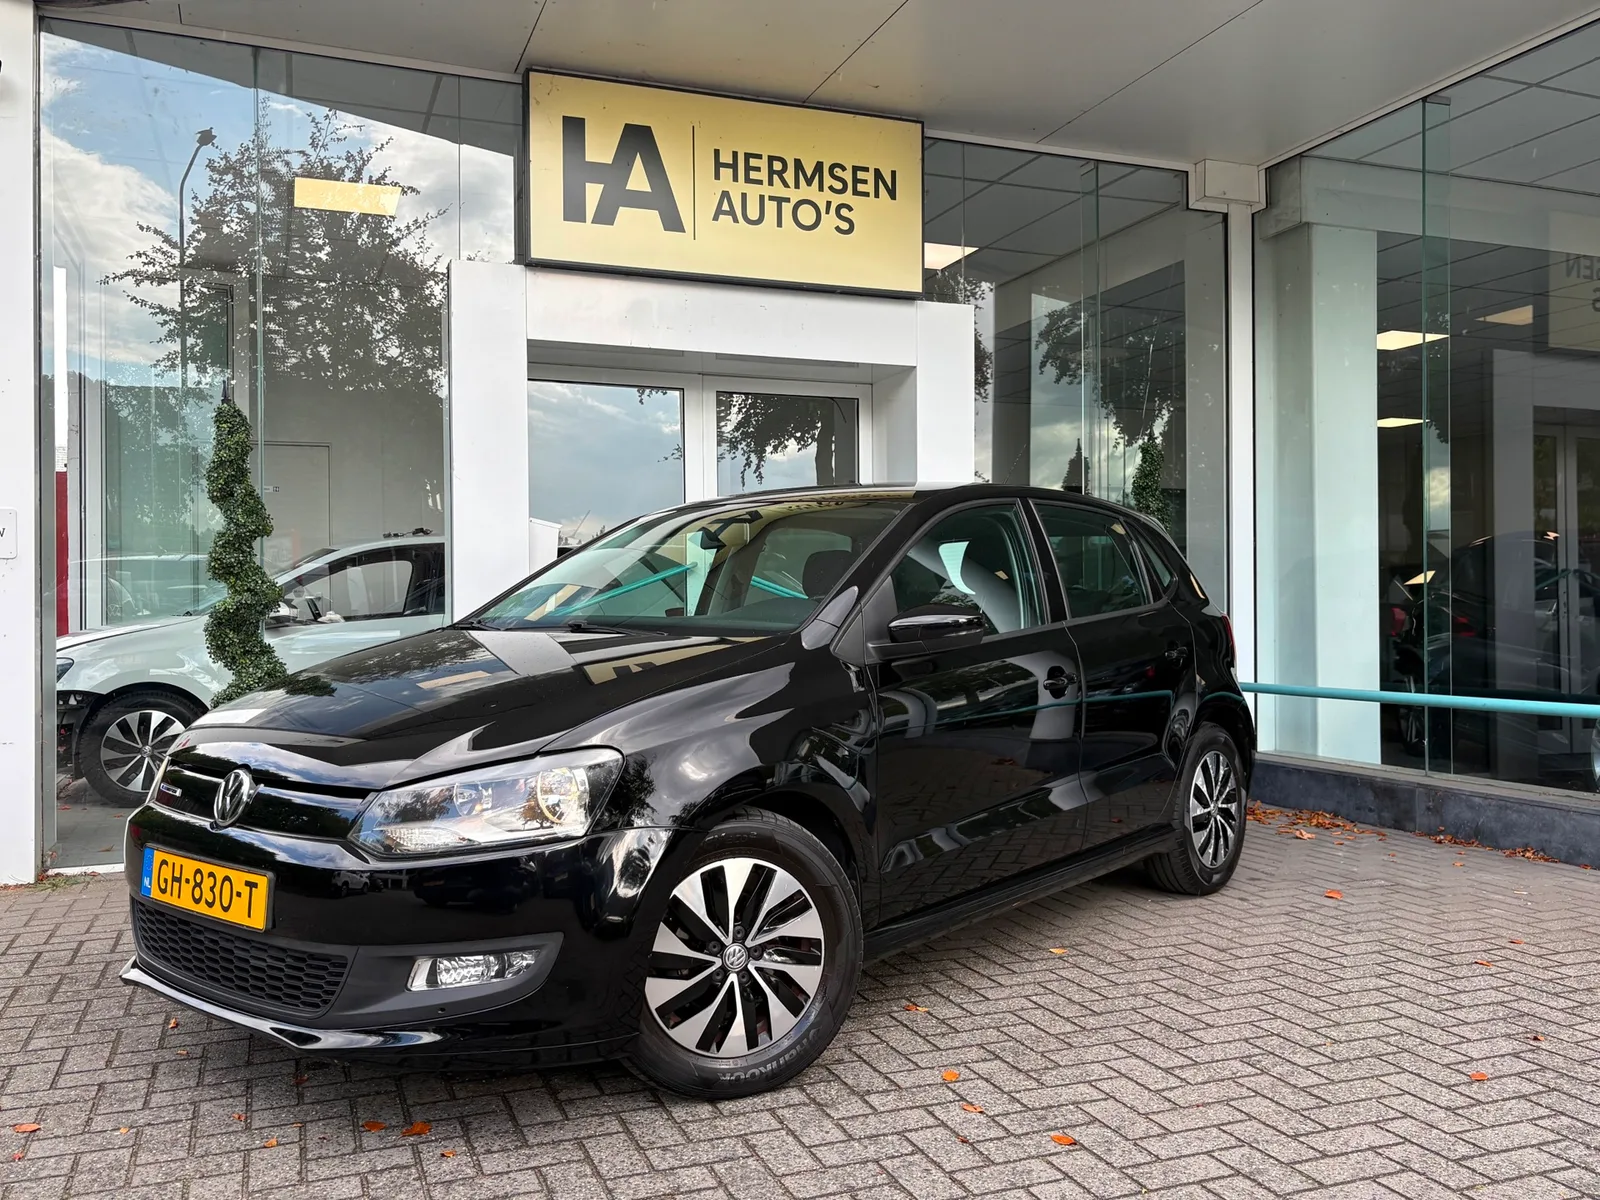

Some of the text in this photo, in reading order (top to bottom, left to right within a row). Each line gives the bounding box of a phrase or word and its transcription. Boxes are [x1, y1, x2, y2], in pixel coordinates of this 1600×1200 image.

[562, 115, 686, 233] HA
[713, 148, 897, 200] HERMSEN
[712, 190, 855, 235] AUTO'S
[143, 859, 258, 919] NL GH-830-T
